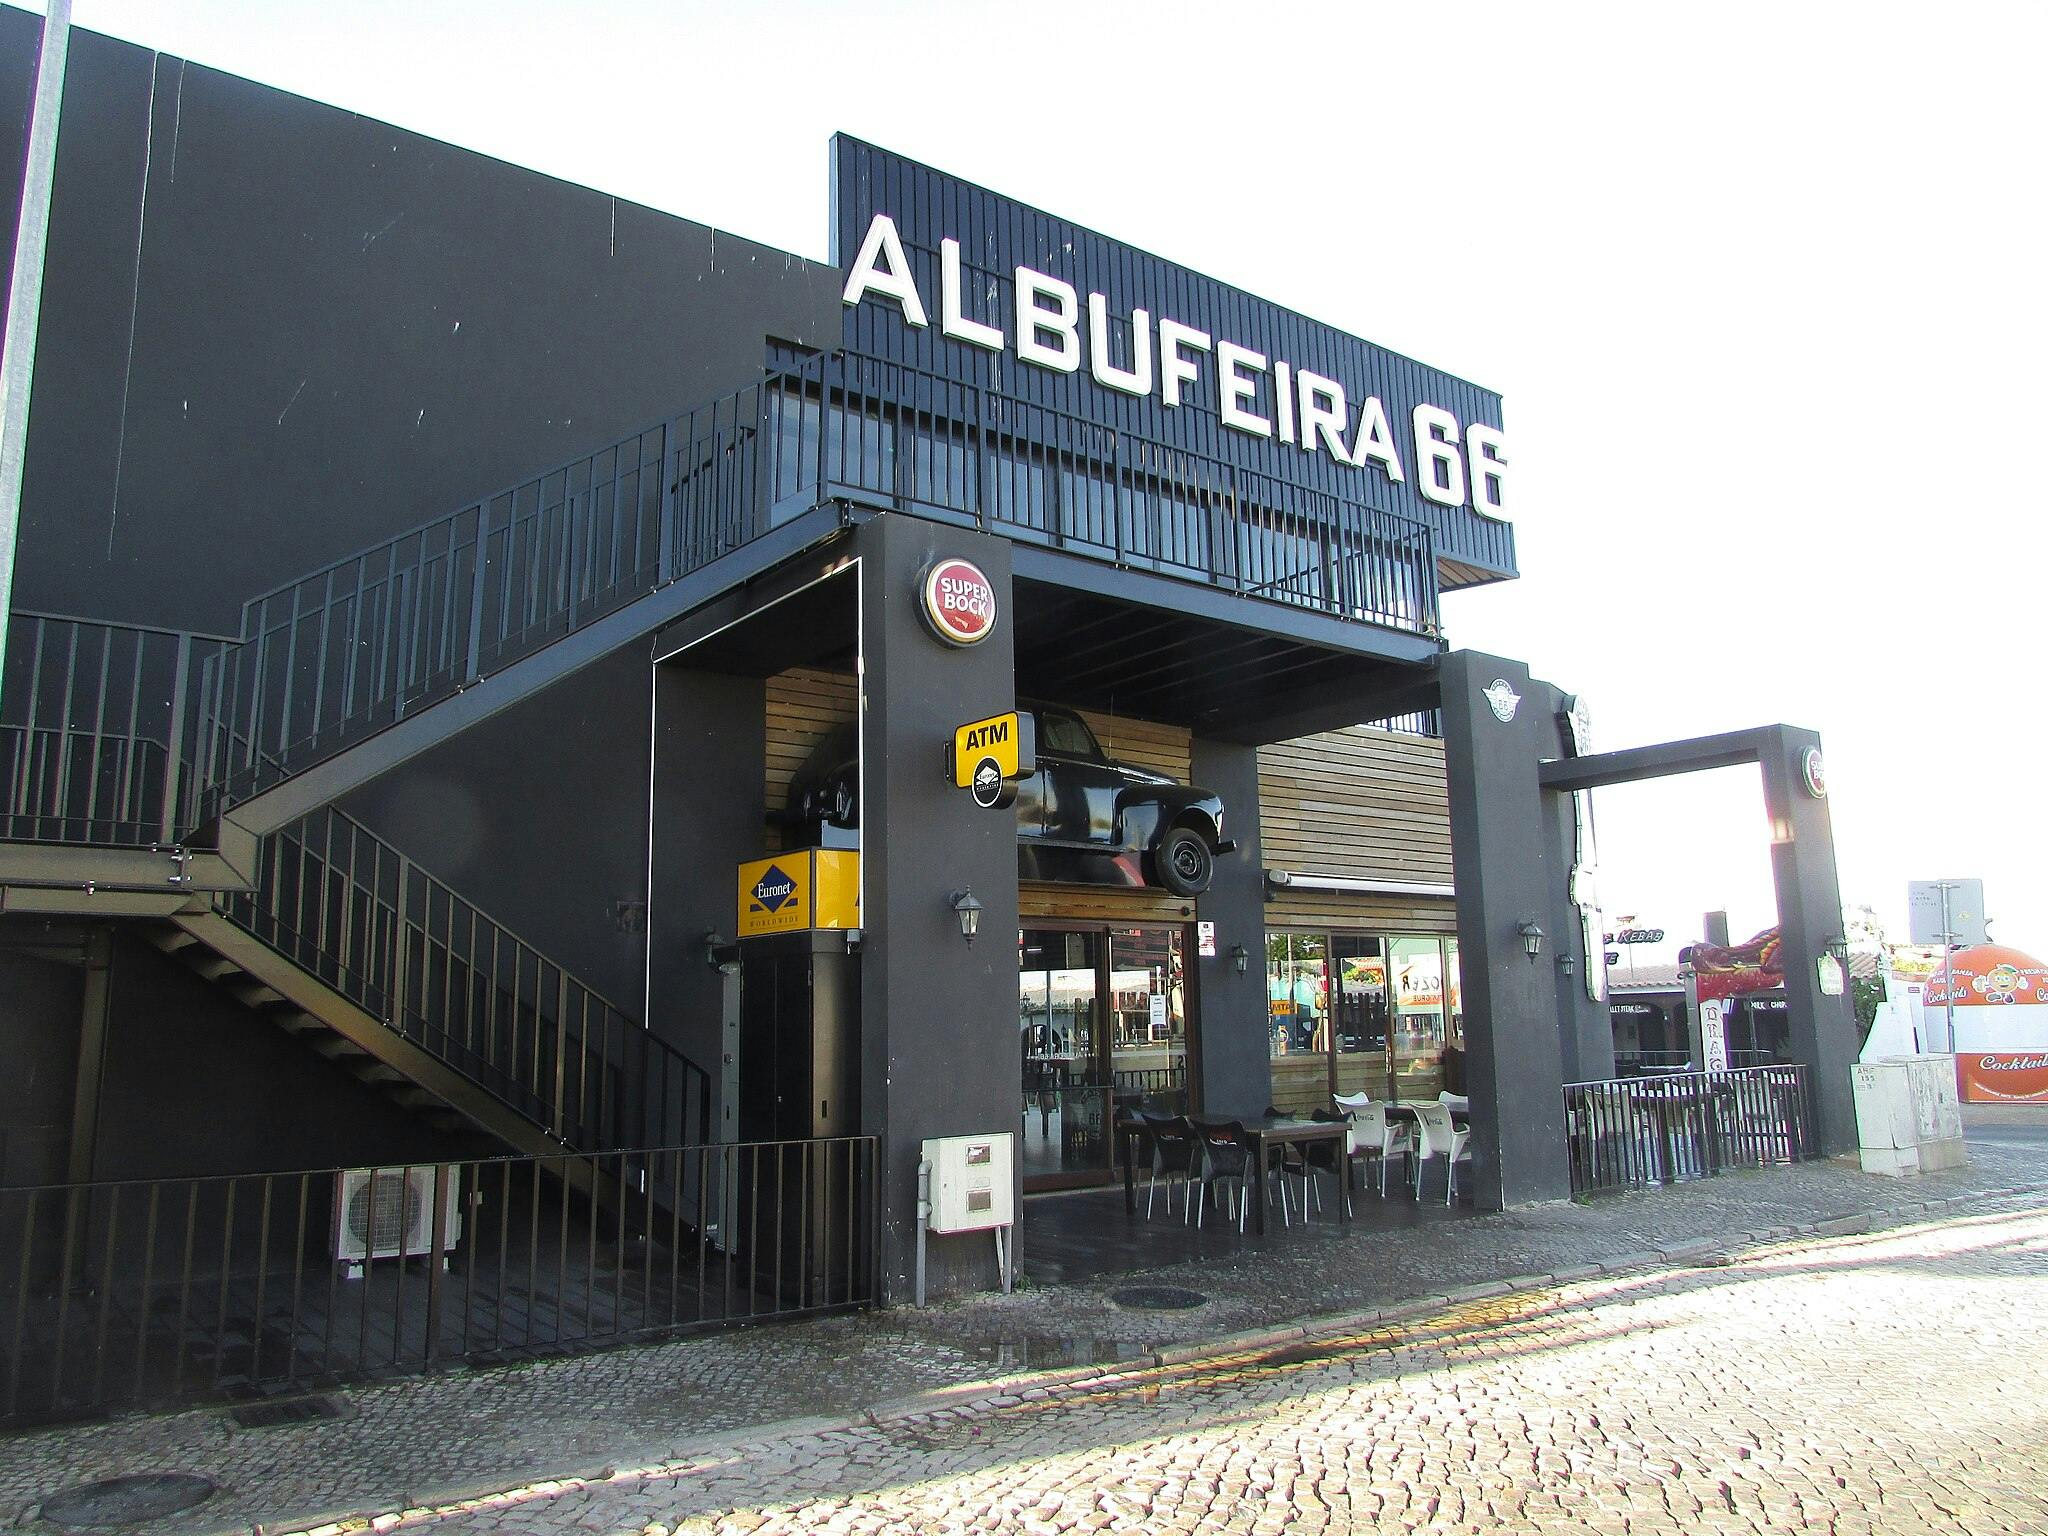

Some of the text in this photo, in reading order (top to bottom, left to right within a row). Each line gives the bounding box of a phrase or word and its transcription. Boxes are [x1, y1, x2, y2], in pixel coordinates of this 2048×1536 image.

[842, 213, 1510, 523] ALBUFEIRA 66
[940, 577, 988, 603] SUPER
[944, 593, 987, 618] BOCK
[966, 721, 1008, 751] ATM
[757, 881, 791, 898] Euronet
[750, 916, 798, 927] WORLDWIDE
[1618, 929, 1664, 943] KEBAB
[1927, 987, 1967, 1004] Cockils
